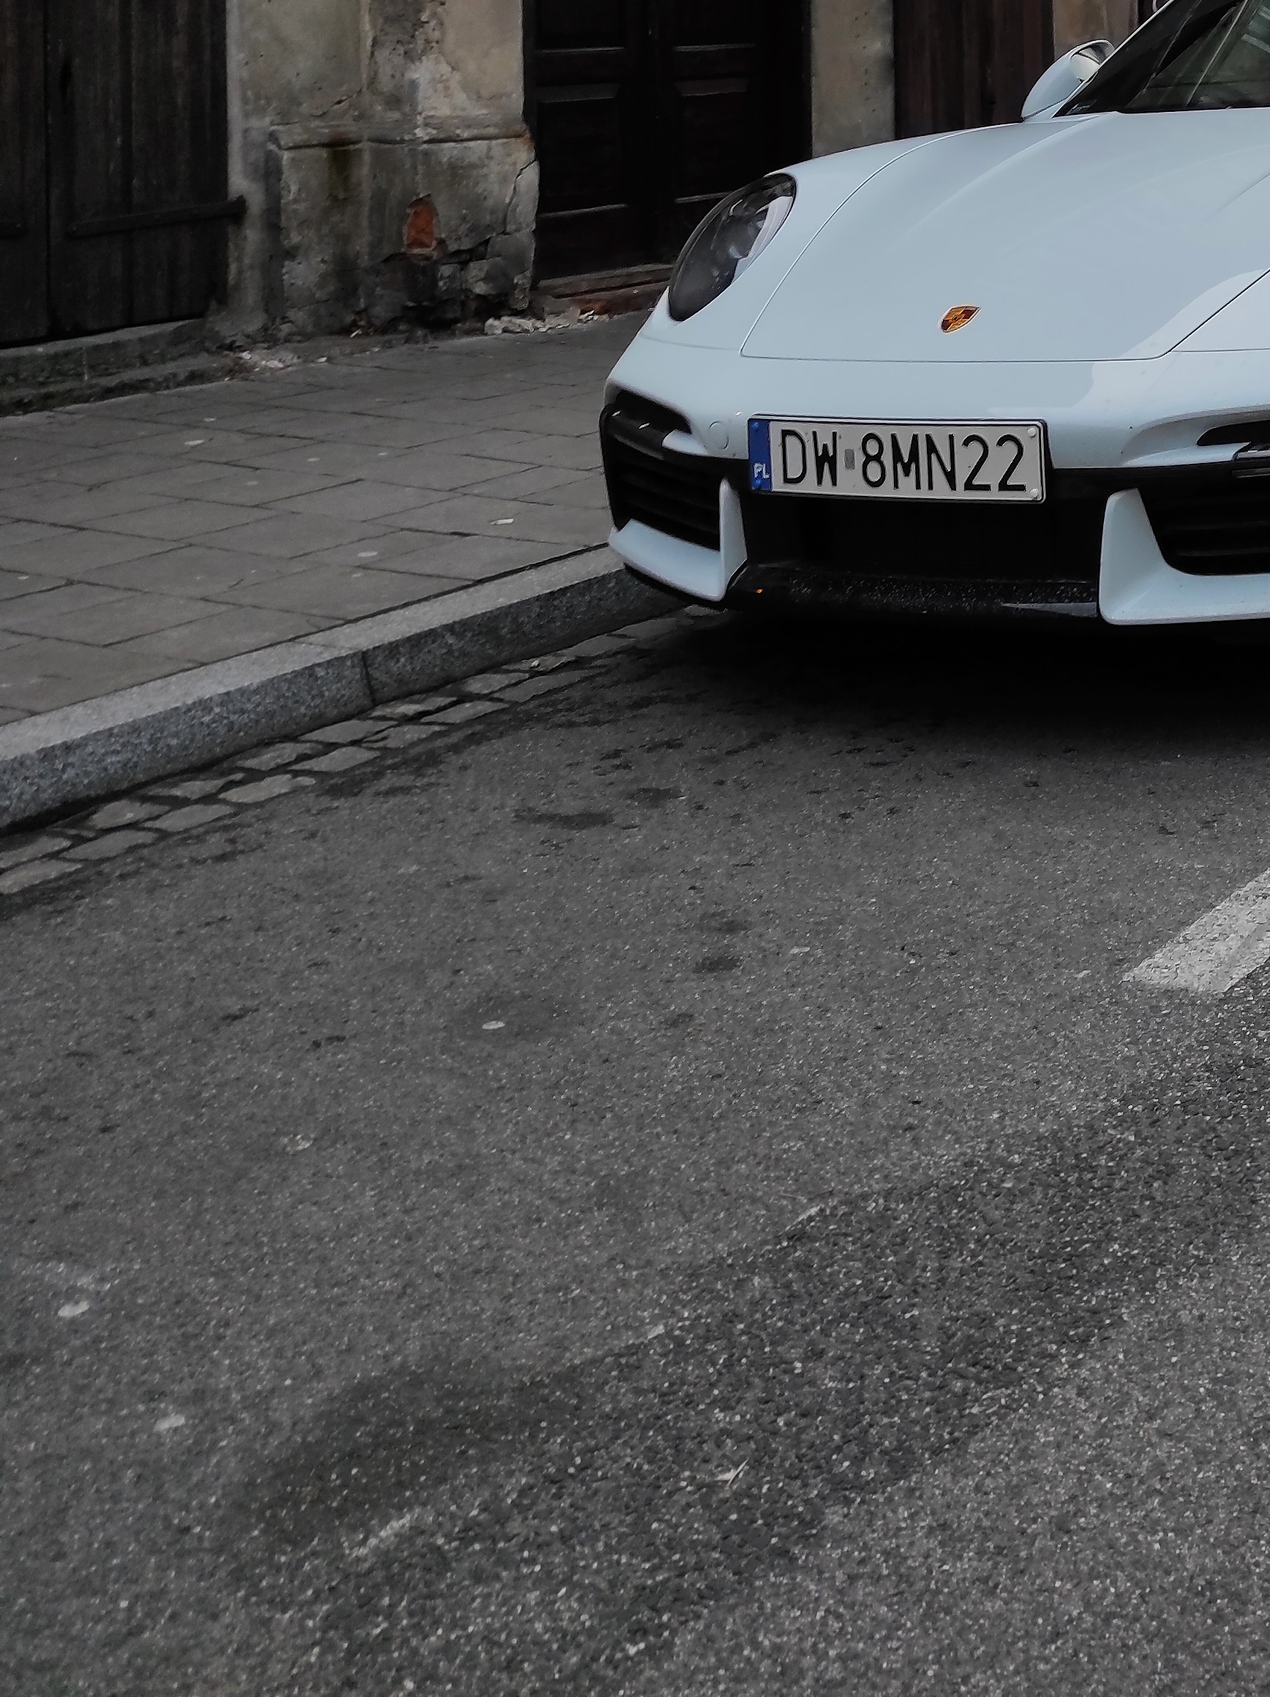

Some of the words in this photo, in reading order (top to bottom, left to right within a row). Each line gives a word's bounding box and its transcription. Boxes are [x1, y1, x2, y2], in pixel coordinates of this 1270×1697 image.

[753, 462, 770, 479] PL
[780, 428, 838, 488] DW
[860, 432, 1027, 493] 8MN22
